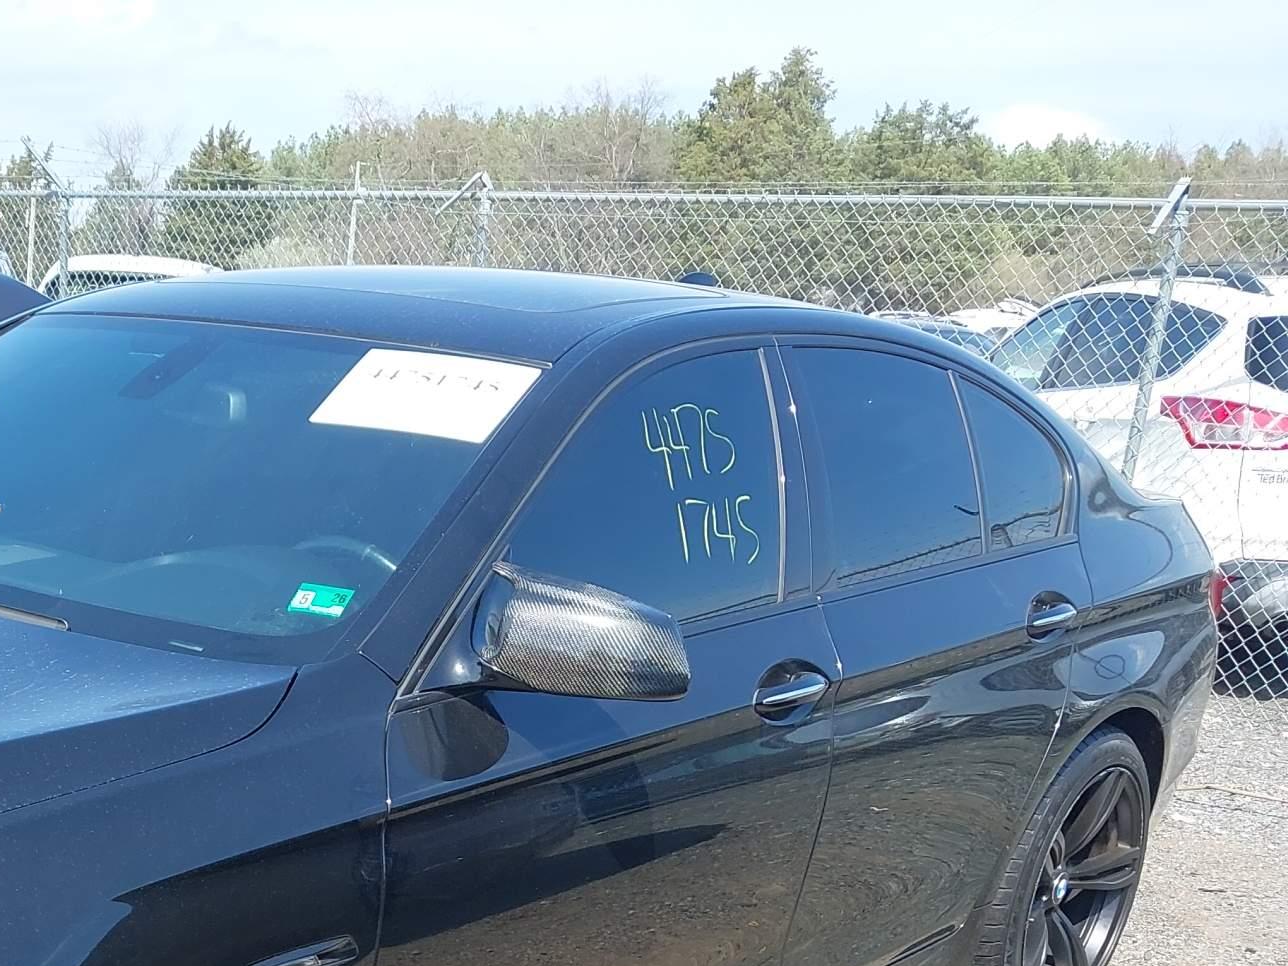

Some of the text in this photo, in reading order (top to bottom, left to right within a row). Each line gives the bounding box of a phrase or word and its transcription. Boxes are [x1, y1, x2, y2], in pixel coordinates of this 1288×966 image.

[640, 403, 736, 491] 4475
[677, 495, 760, 565] 1745
[300, 593, 348, 605] 5 26
